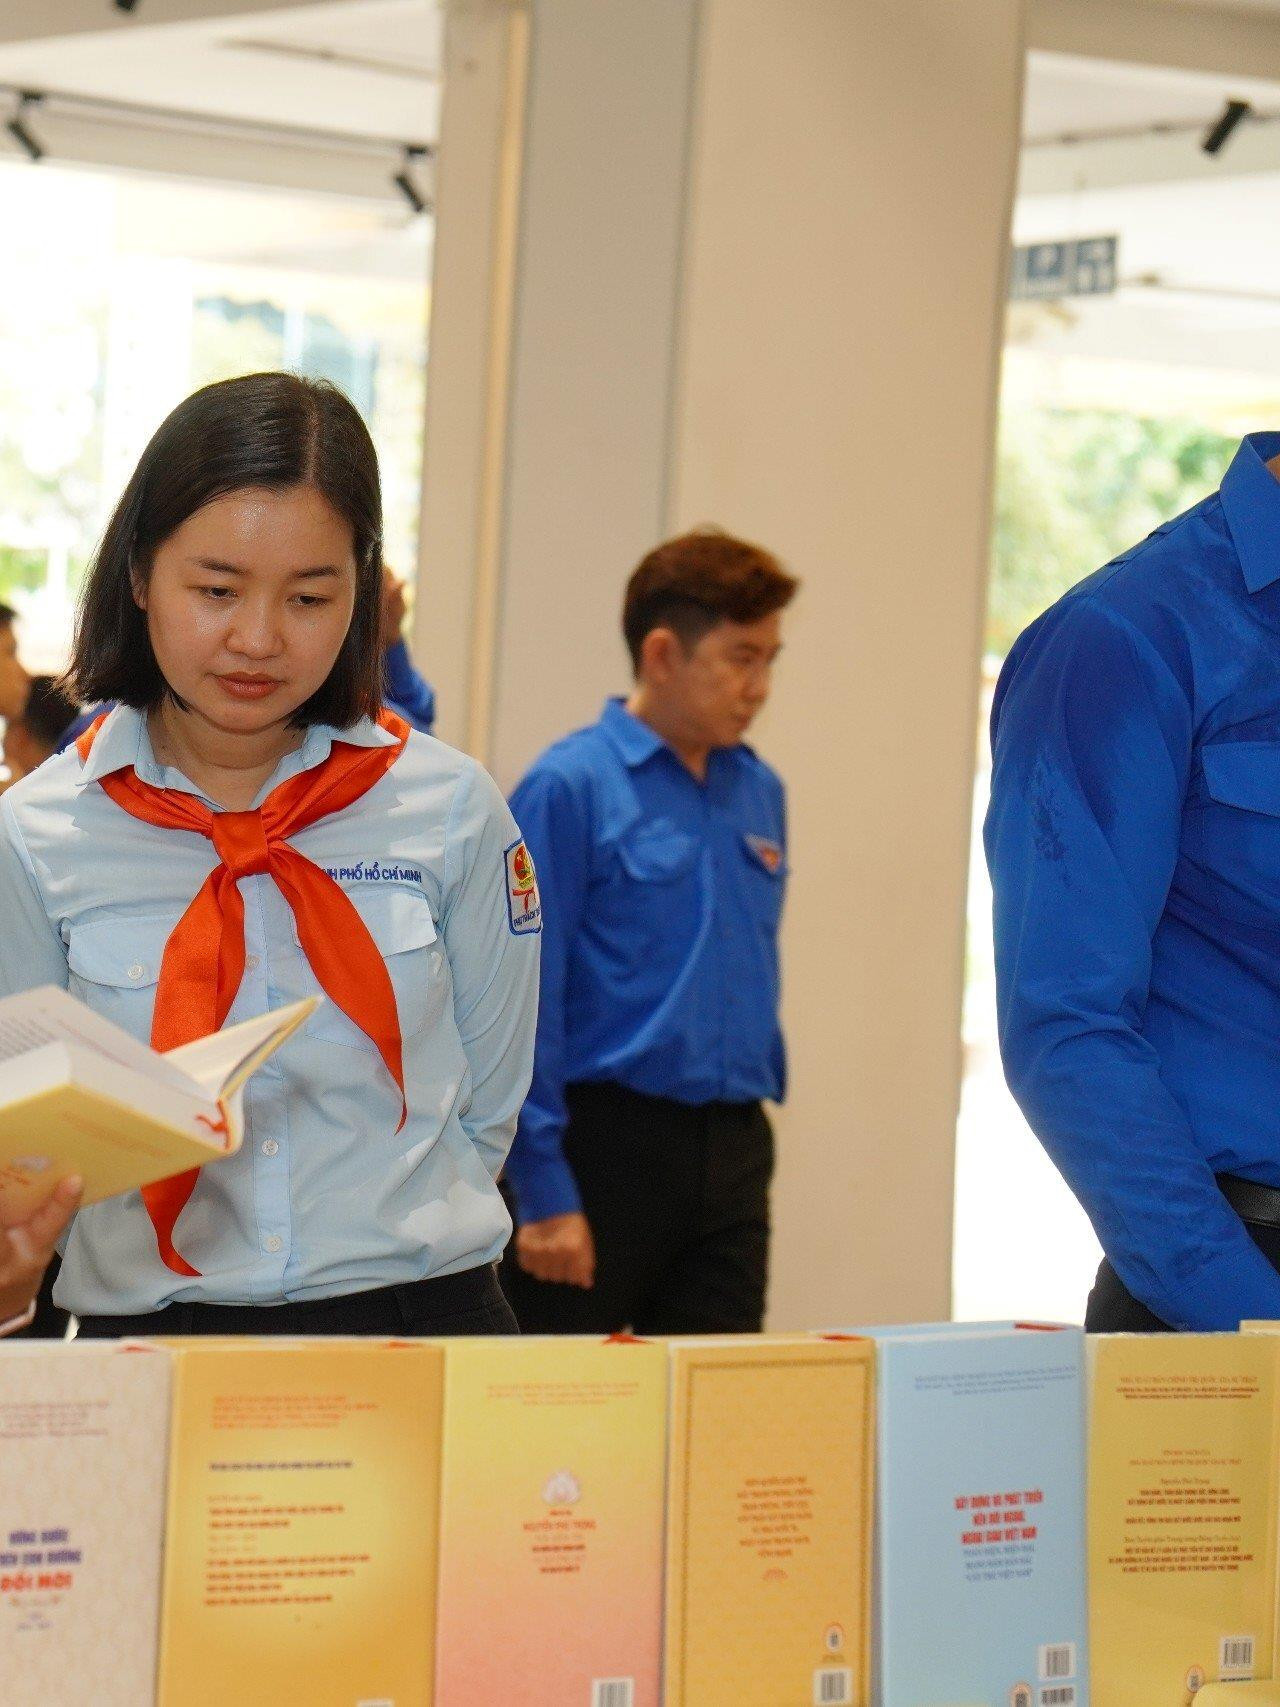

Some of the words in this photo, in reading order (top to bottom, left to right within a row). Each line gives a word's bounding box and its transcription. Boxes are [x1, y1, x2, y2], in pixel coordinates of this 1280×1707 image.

[339, 861, 364, 881] PHỐ
[364, 861, 381, 881] HỒ
[381, 865, 399, 881] CHÍ
[399, 868, 422, 883] MINH
